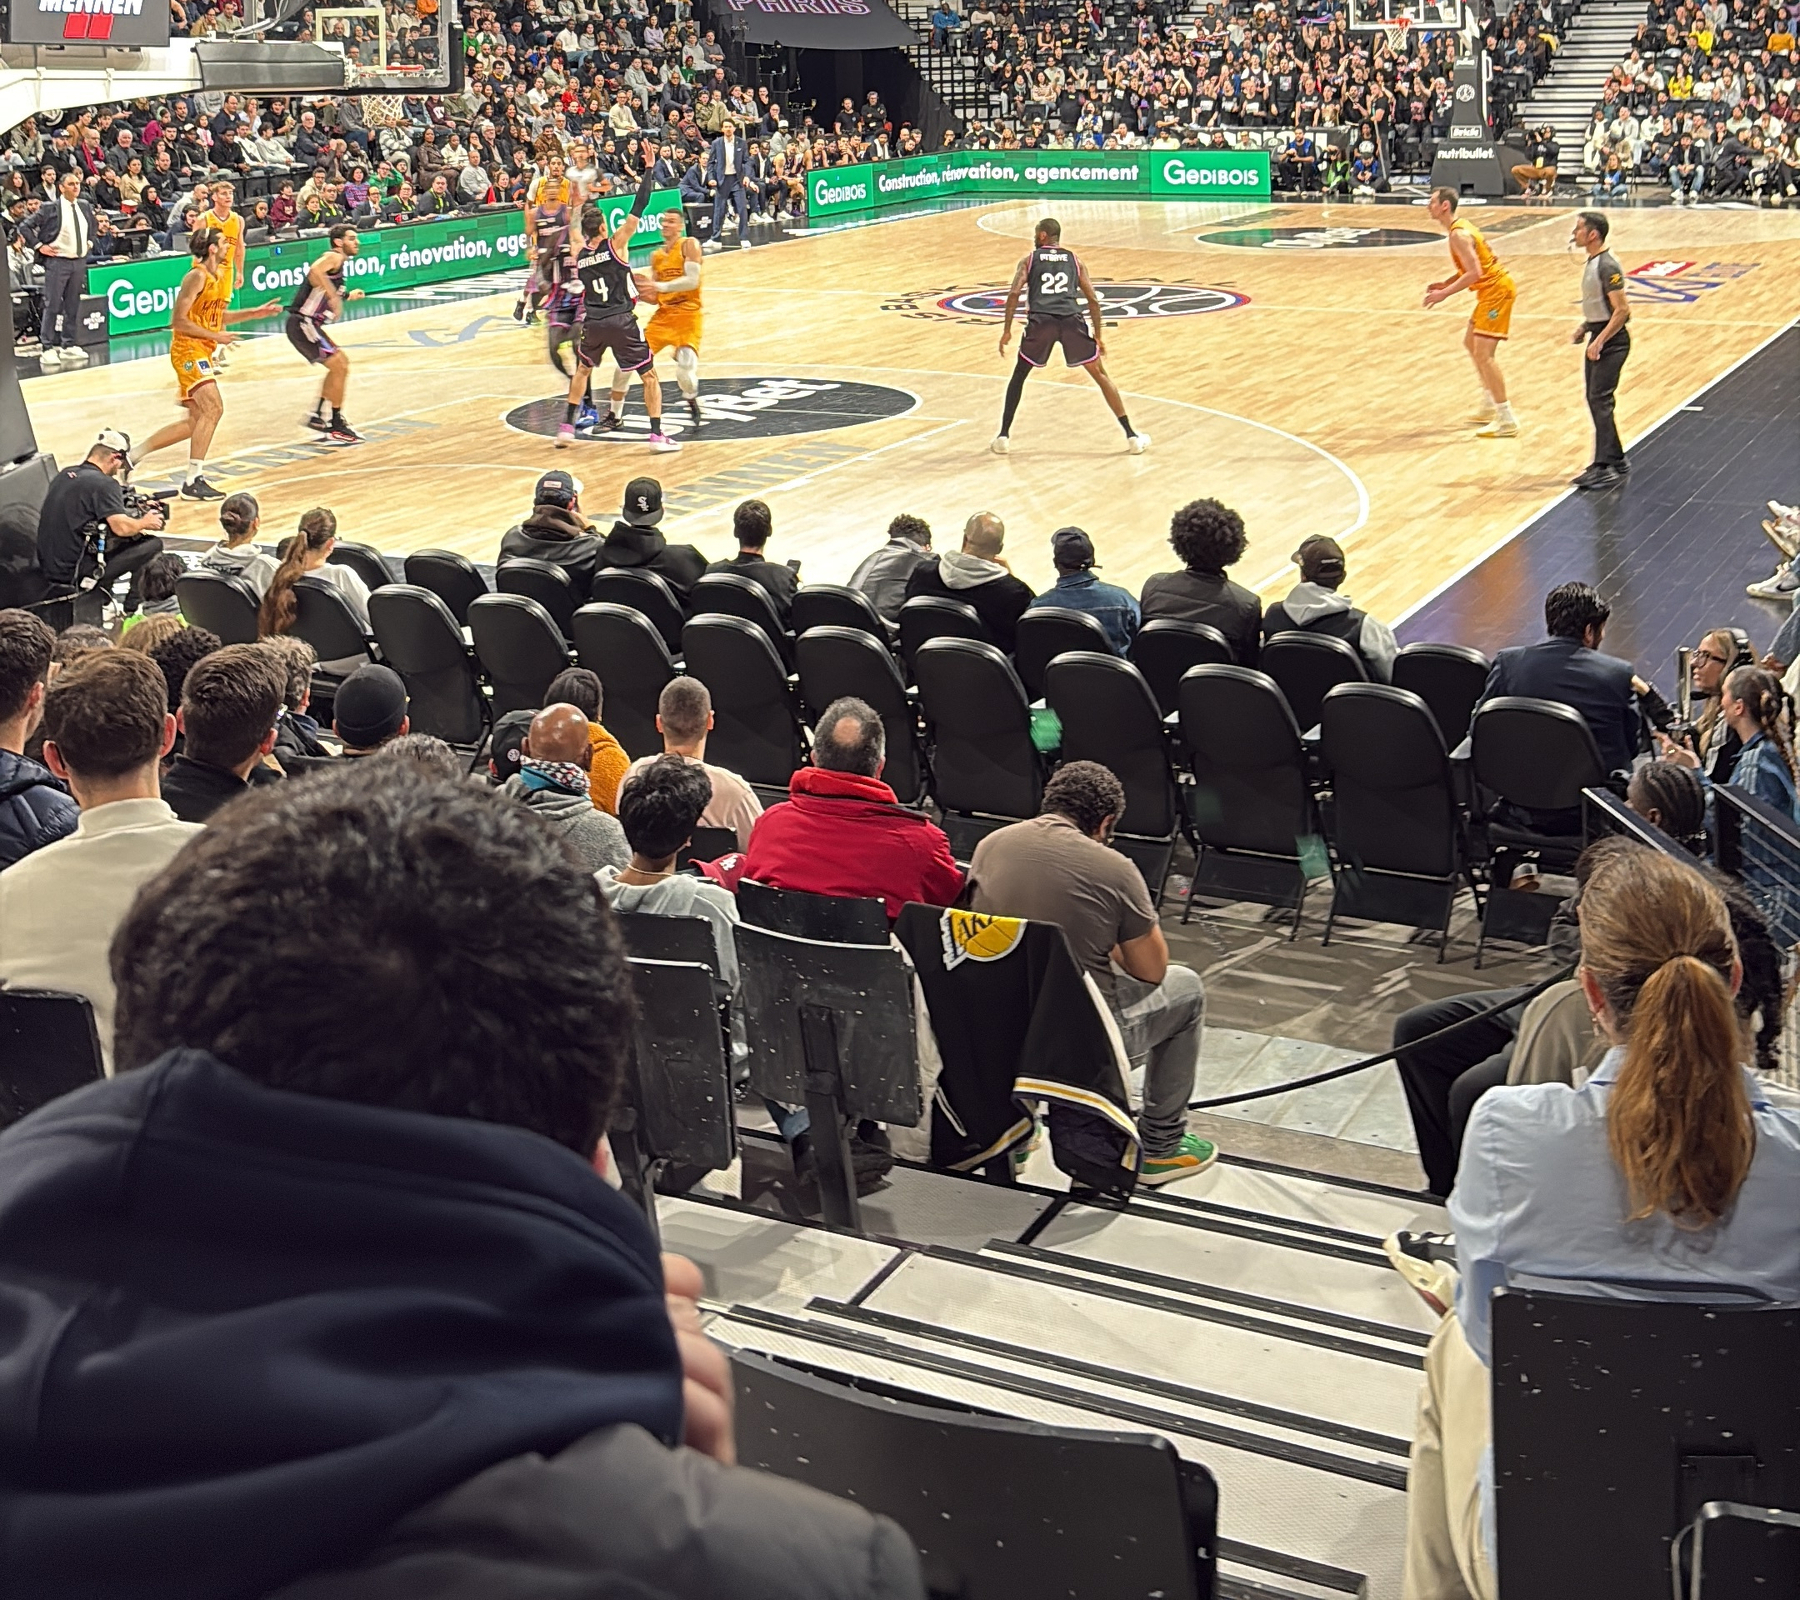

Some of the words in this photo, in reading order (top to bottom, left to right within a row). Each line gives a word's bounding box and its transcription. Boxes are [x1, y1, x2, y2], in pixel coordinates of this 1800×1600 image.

[878, 168, 940, 193] Construction,
[941, 162, 1020, 184] rénovation,
[1024, 164, 1139, 185] agencement
[390, 236, 492, 270] rénovation,
[592, 277, 609, 302] 4
[1041, 272, 1068, 294] 22
